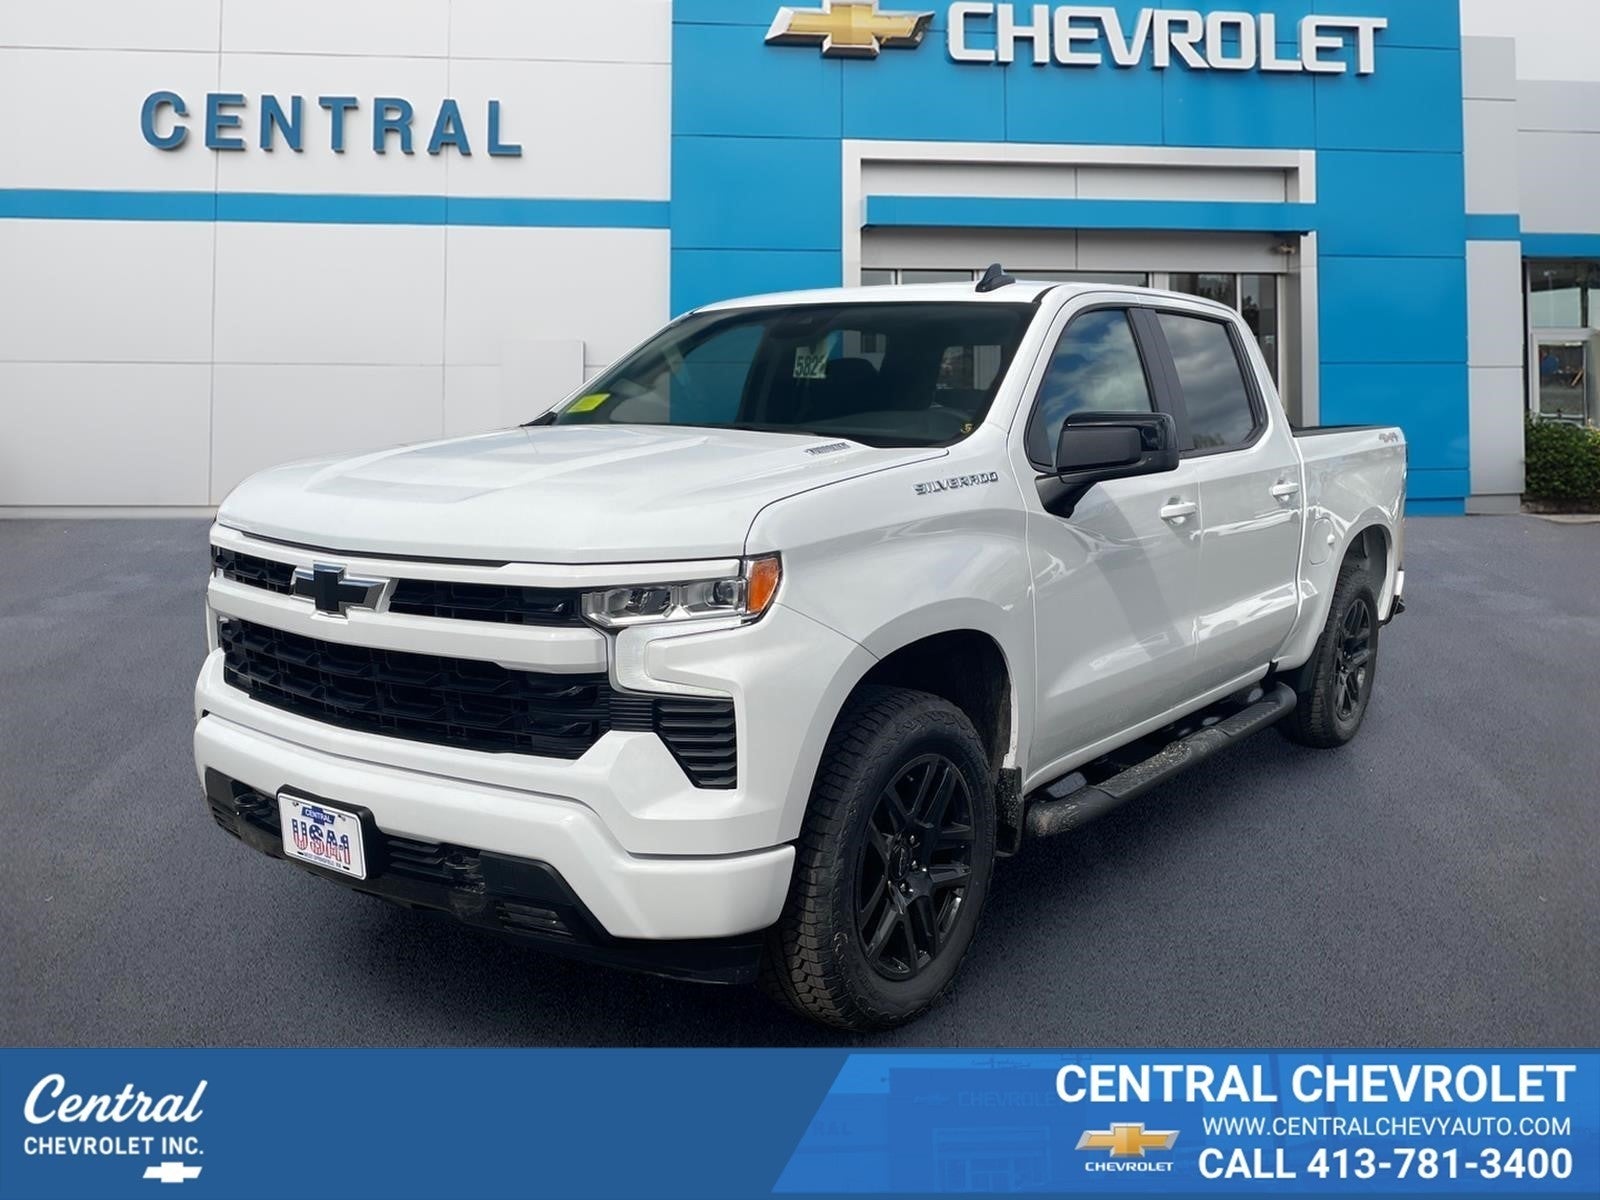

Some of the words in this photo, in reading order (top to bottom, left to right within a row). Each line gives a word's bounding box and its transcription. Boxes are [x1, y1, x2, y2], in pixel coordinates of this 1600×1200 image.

[948, 1, 1388, 75] CHEVROLET
[140, 91, 522, 157] CENTRAL
[914, 471, 999, 495] SILVERADO
[304, 808, 333, 823] CENTRAL
